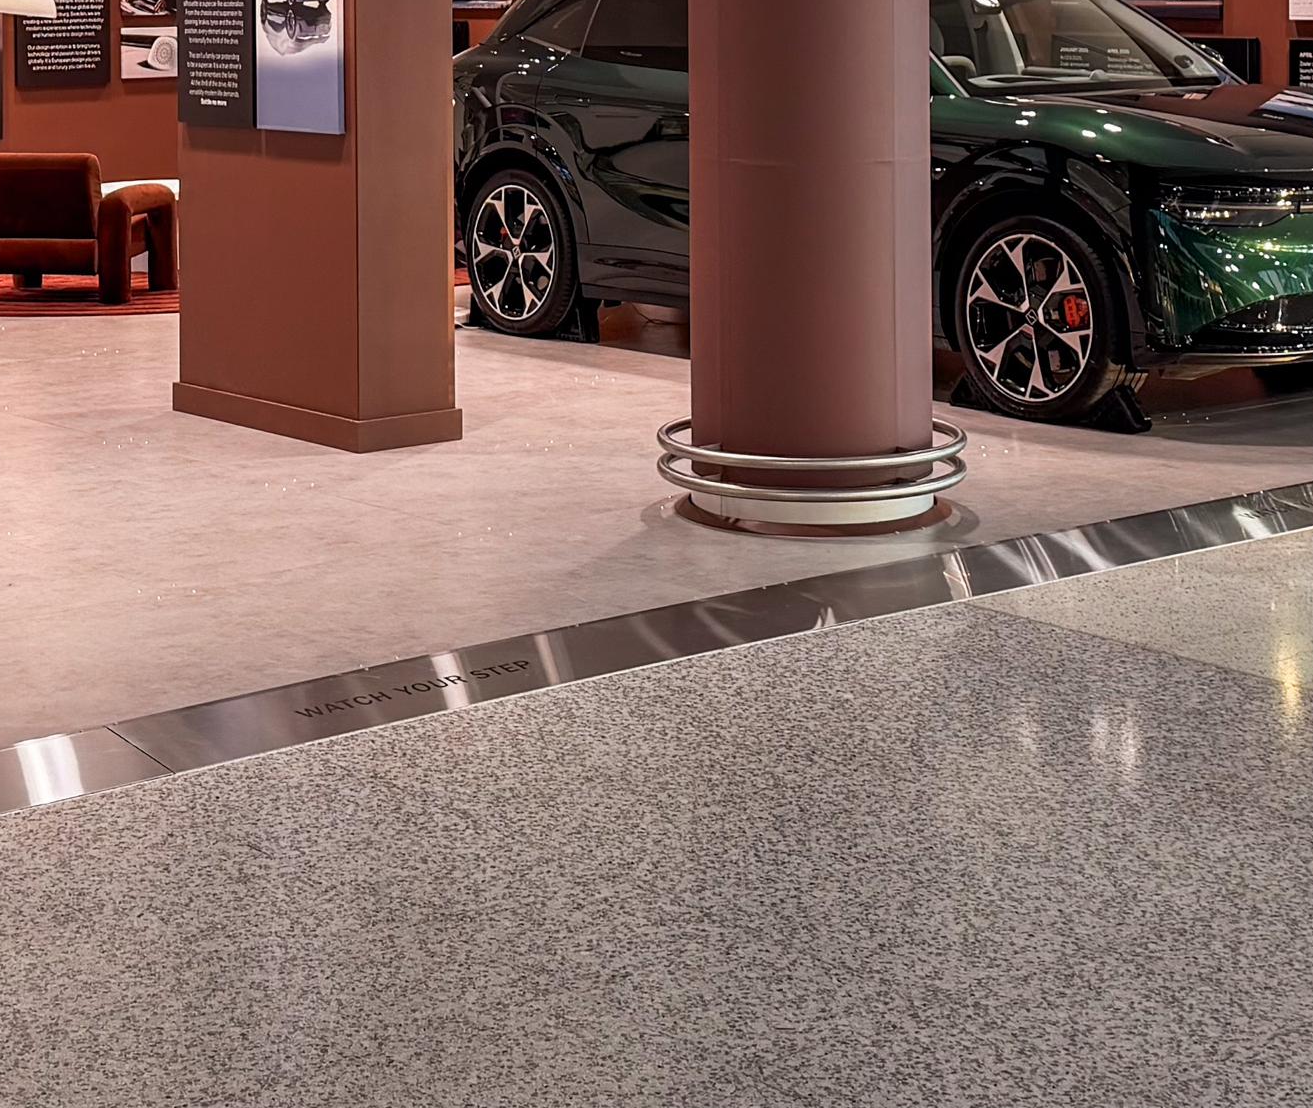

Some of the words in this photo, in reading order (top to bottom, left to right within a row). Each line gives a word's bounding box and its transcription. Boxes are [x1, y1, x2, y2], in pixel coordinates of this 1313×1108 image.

[295, 691, 392, 719] WATCH
[394, 674, 469, 696] YOUR
[470, 659, 530, 680] STEP
